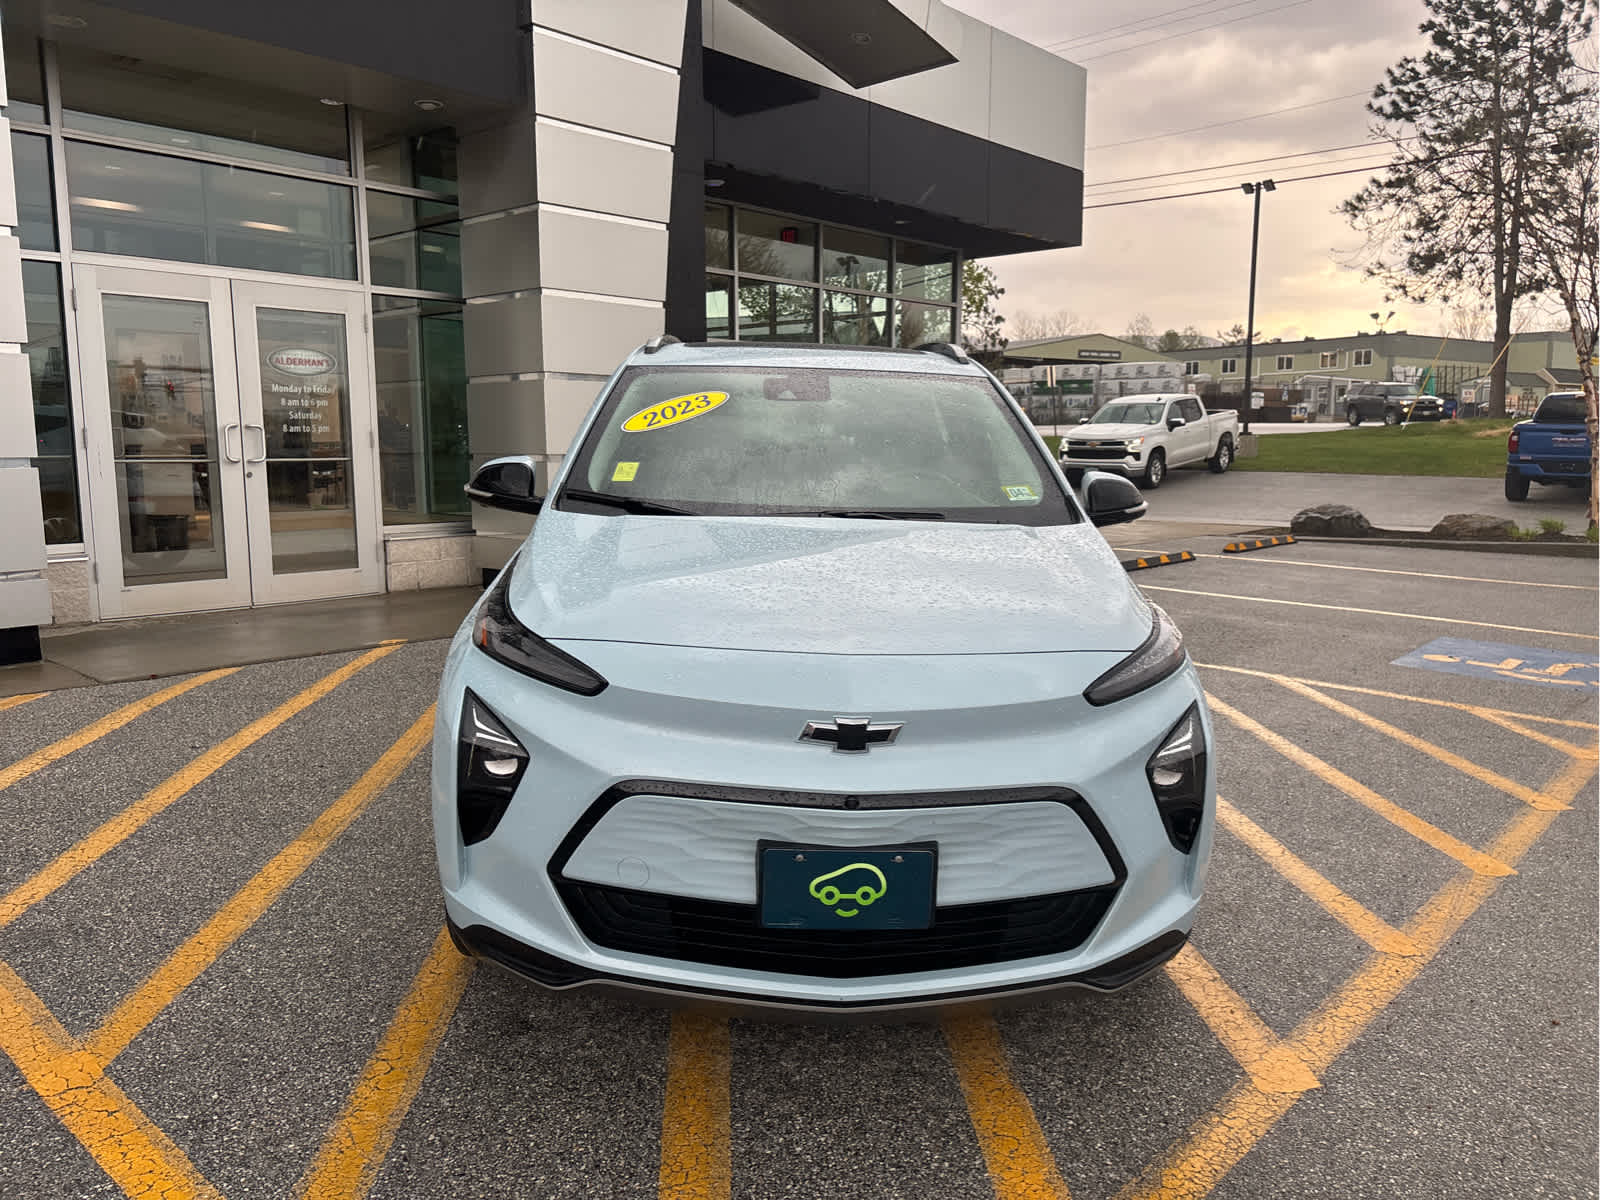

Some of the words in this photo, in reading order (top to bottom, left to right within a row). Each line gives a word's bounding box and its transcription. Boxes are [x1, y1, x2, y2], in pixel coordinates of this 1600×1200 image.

[272, 383, 302, 395] Monday
[303, 384, 312, 393] to
[281, 398, 286, 406] 8
[288, 399, 300, 407] am
[301, 399, 309, 407] to
[317, 400, 328, 408] pm
[289, 411, 322, 420] Saturday
[643, 395, 711, 427] 2023
[283, 424, 288, 432] 8
[289, 425, 301, 433] am
[302, 424, 311, 433] to
[318, 425, 329, 434] pm
